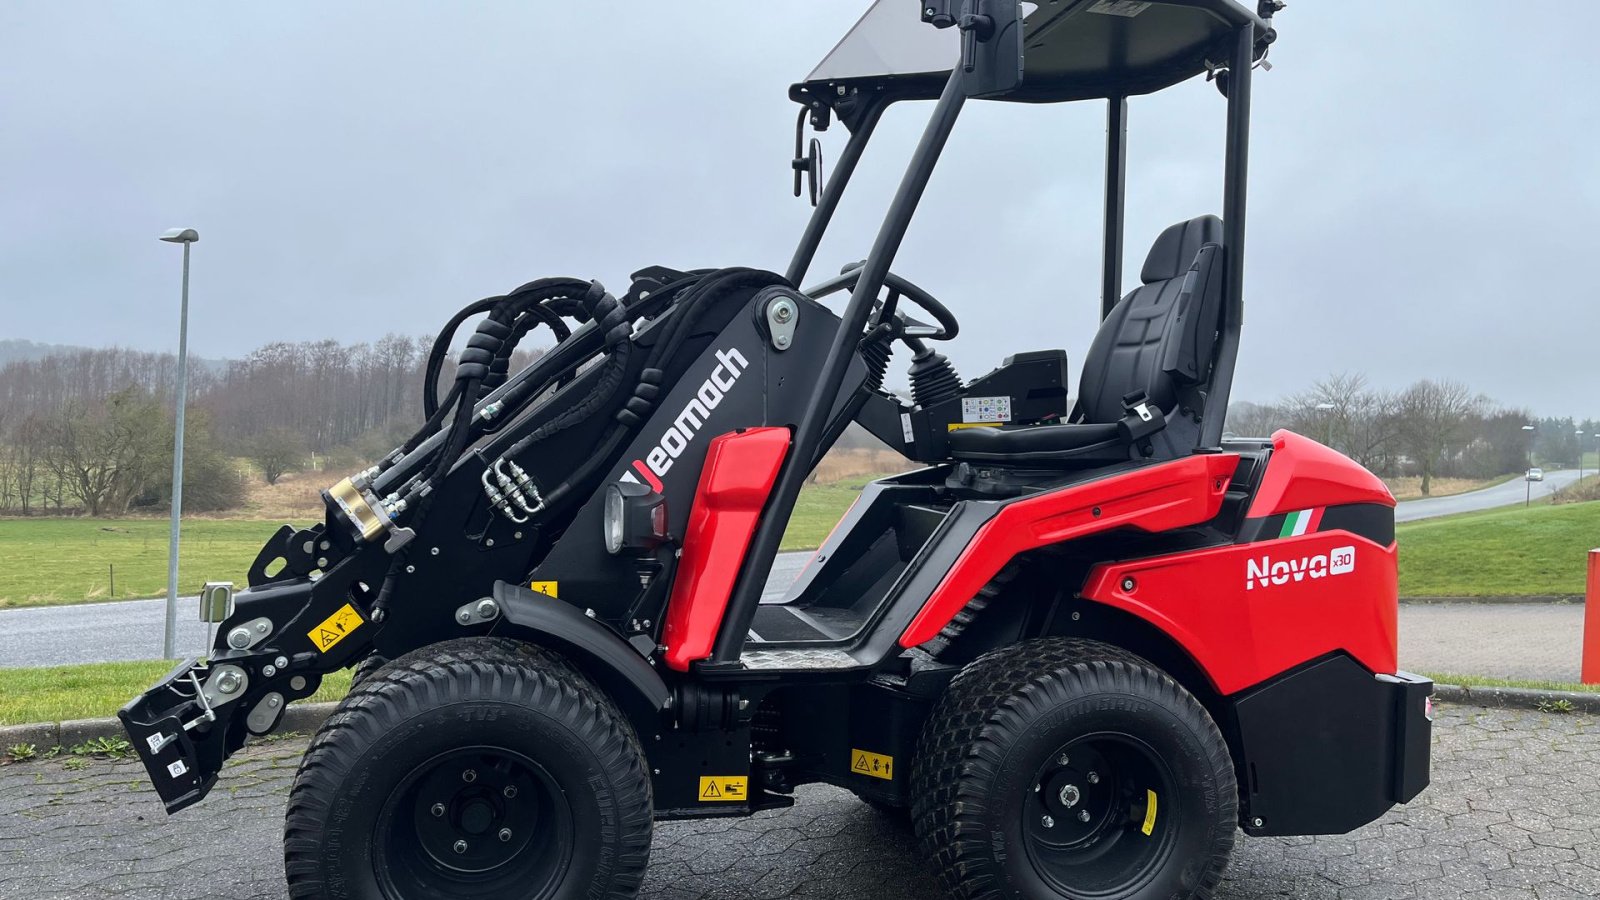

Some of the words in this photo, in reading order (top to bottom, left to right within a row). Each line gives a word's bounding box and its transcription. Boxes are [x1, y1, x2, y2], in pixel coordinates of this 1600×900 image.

[1246, 555, 1328, 591] Nova
[1332, 553, 1352, 568] x30
[1095, 697, 1147, 713] GRIP
